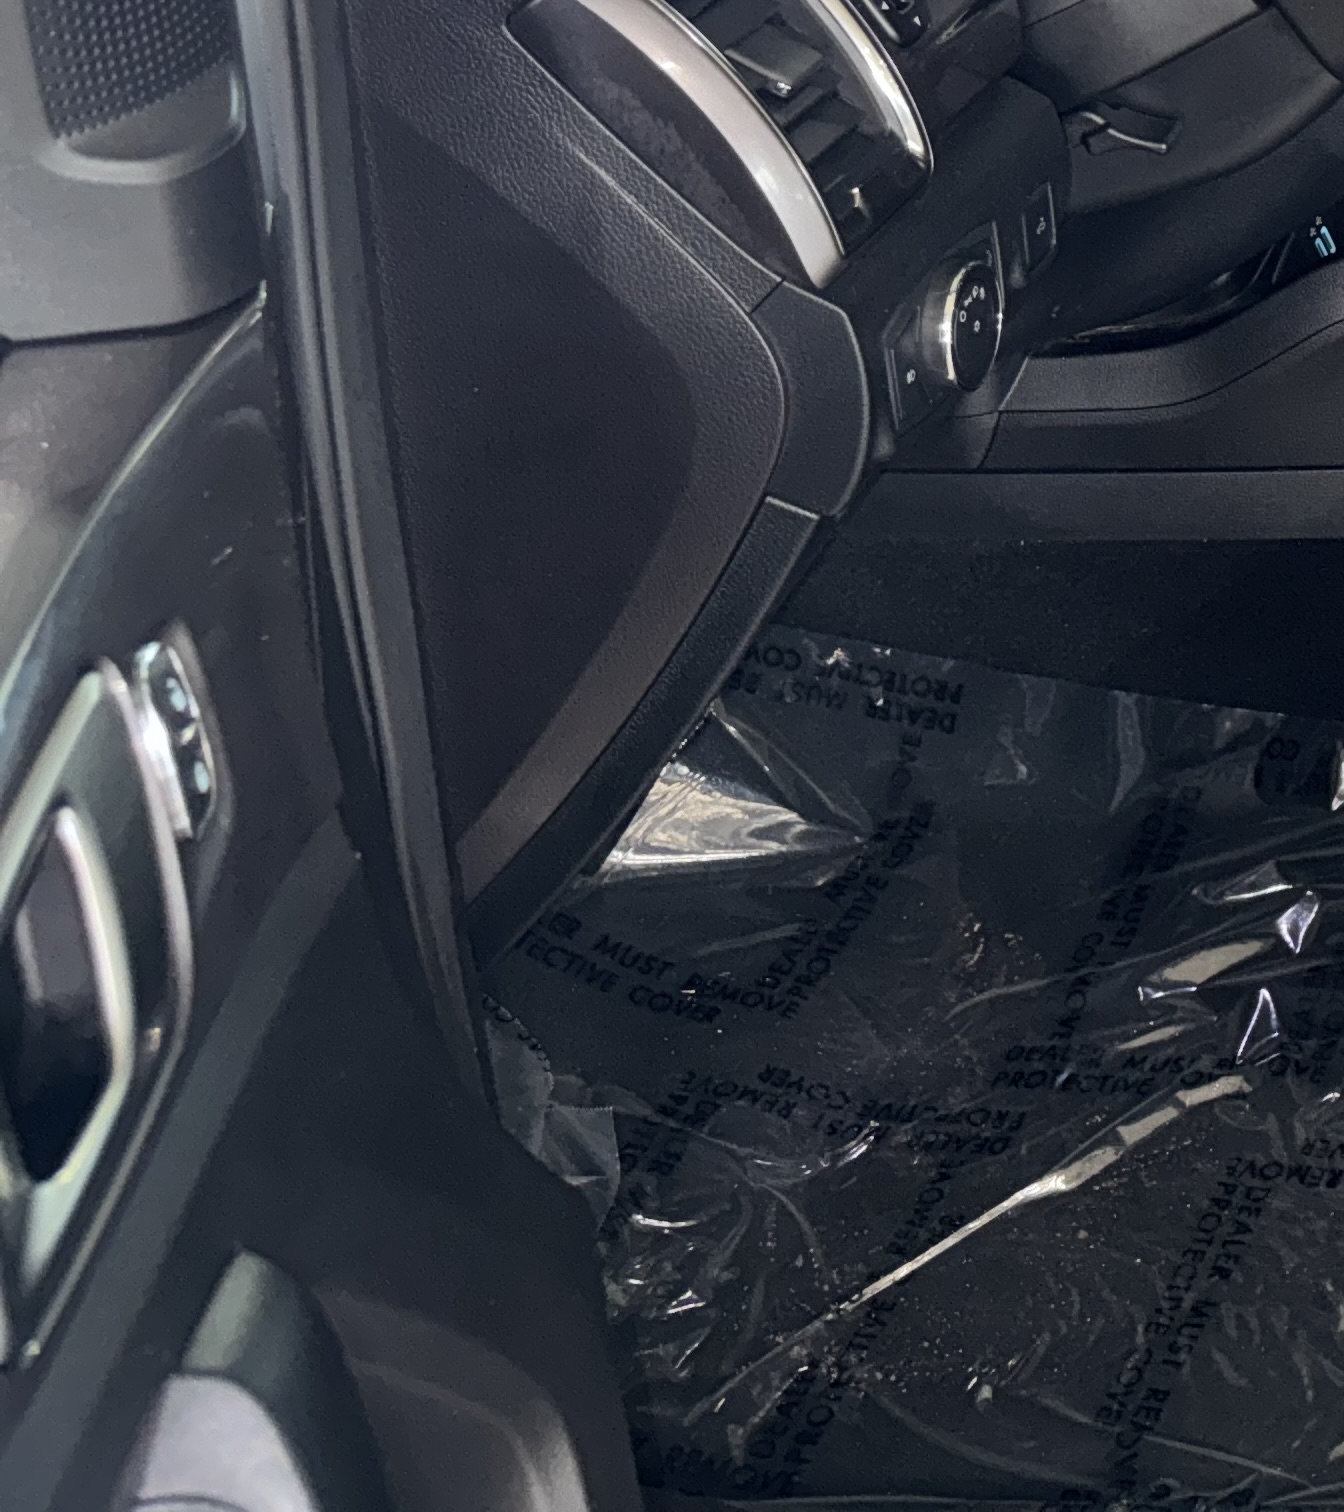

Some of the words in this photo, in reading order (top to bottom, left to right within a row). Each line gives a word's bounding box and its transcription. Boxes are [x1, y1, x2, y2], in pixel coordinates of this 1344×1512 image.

[591, 931, 678, 979] MUST
[1224, 1155, 1344, 1189] REMOVE
[1206, 1183, 1271, 1280] DEALER
